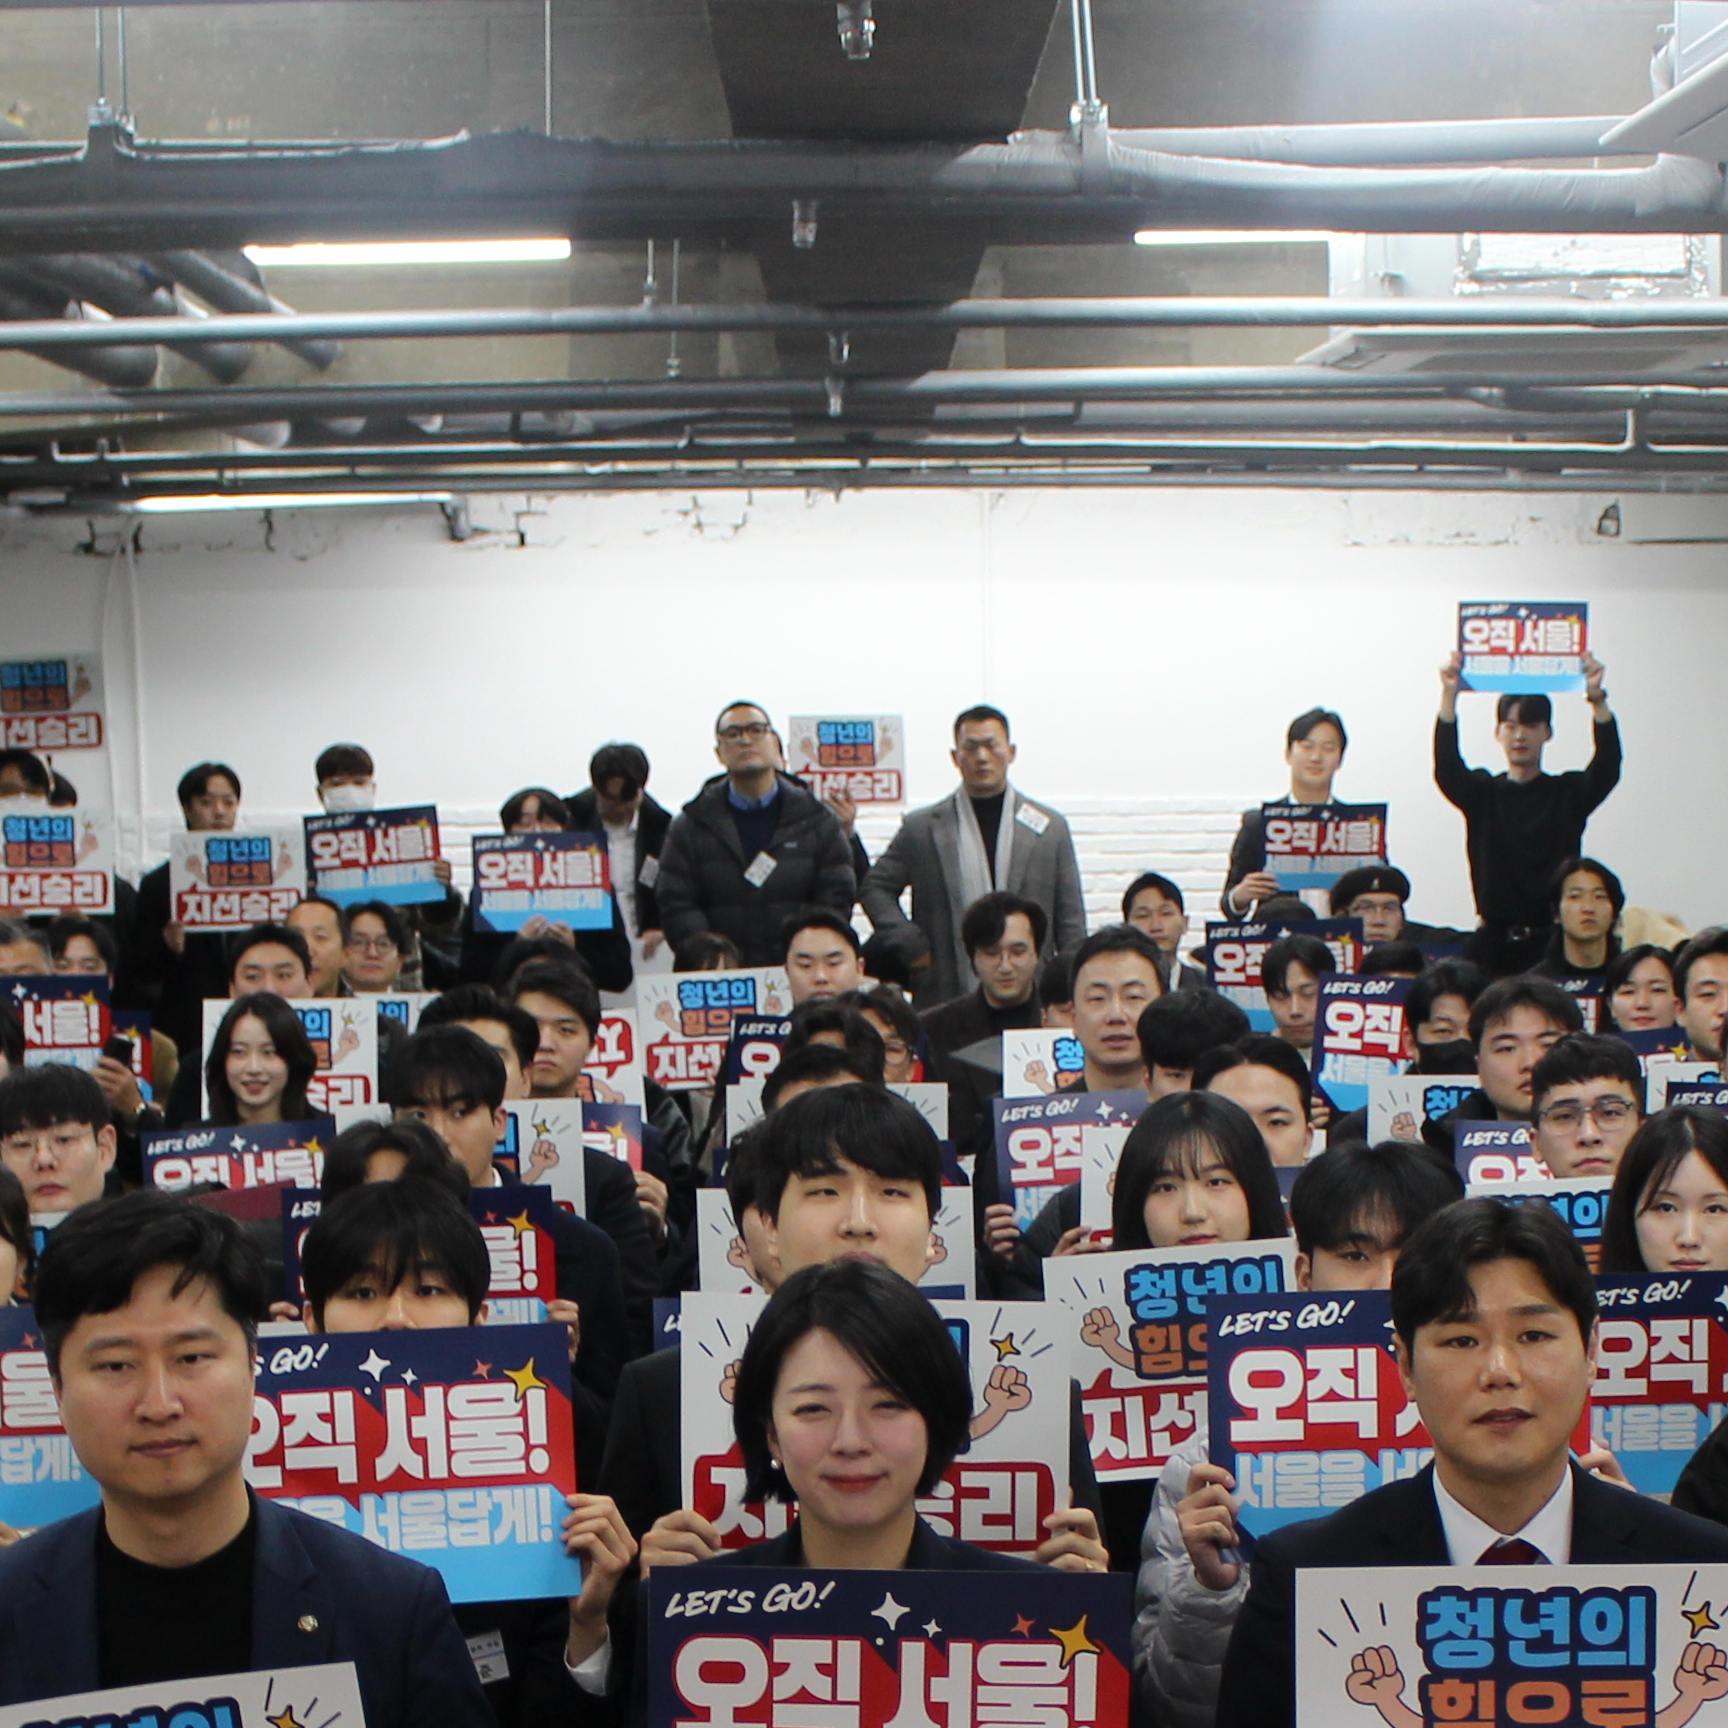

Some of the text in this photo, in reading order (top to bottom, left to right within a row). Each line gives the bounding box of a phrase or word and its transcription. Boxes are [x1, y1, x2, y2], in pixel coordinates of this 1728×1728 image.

[1462, 619, 1580, 654] 오직 서울!
[3, 815, 74, 844] 청년의
[311, 823, 434, 868] 오직 서울!
[1266, 819, 1379, 853] 오직 서울!
[478, 852, 534, 888] 오직
[541, 850, 603, 888] 서울!
[678, 974, 757, 1009] 청년의
[1322, 979, 1395, 995] LET'S GO!
[24, 1000, 101, 1046] 서울!
[1323, 1000, 1404, 1054] 오직
[1001, 1097, 1079, 1123] LET'S GO!
[1463, 1131, 1509, 1148] LET'S
[1595, 1279, 1692, 1307] ET'S GO!
[1218, 1300, 1355, 1337] LET'S GO!
[269, 1343, 329, 1375] GO!
[1592, 1318, 1710, 1396] 오직
[1228, 1347, 1378, 1443] 오직
[374, 1384, 551, 1483] 서울!
[1592, 1404, 1697, 1453] 서울을
[1233, 1451, 1366, 1510] 서울을
[361, 1486, 555, 1552] 서울답게!
[665, 1581, 836, 1619] LET'S GO!
[1424, 1595, 1646, 1669] 청년의
